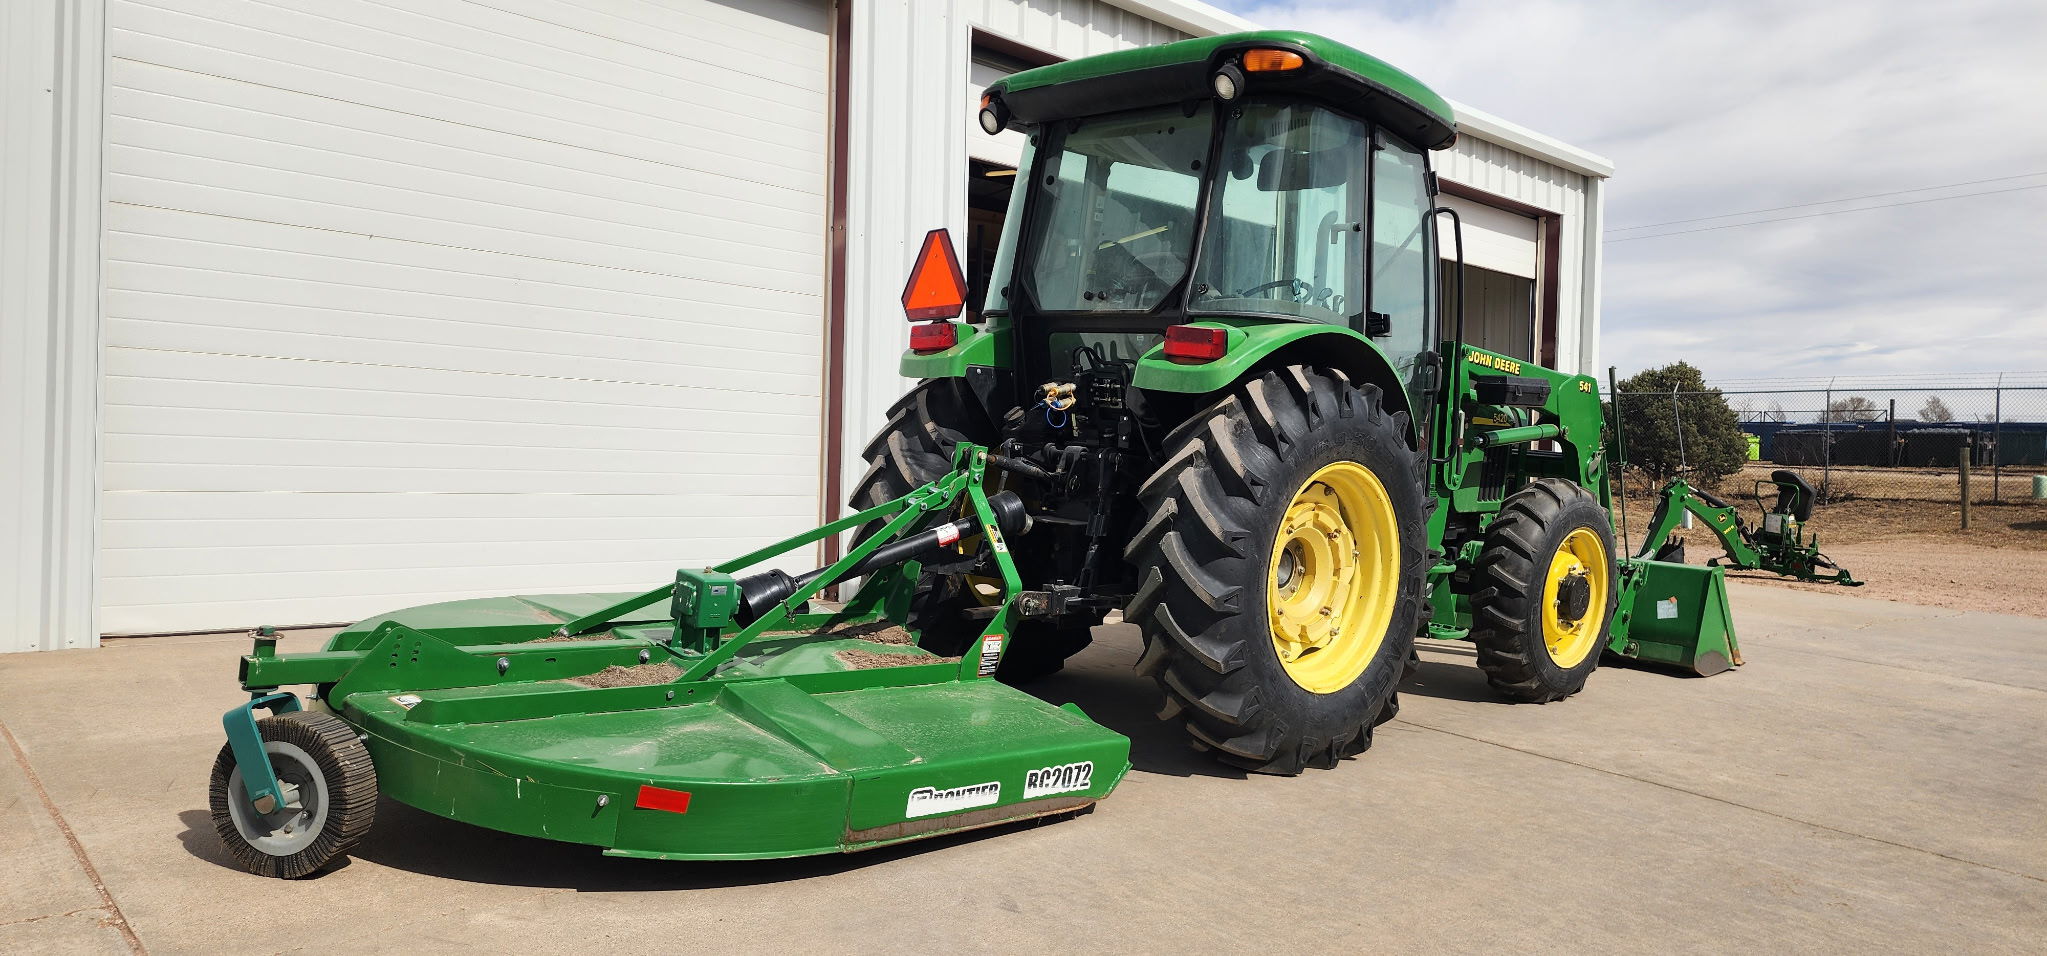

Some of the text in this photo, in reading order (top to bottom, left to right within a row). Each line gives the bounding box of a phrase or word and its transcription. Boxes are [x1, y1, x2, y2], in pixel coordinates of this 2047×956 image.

[1468, 350, 1521, 375] JOHN DEERE
[1579, 380, 1592, 394] 541
